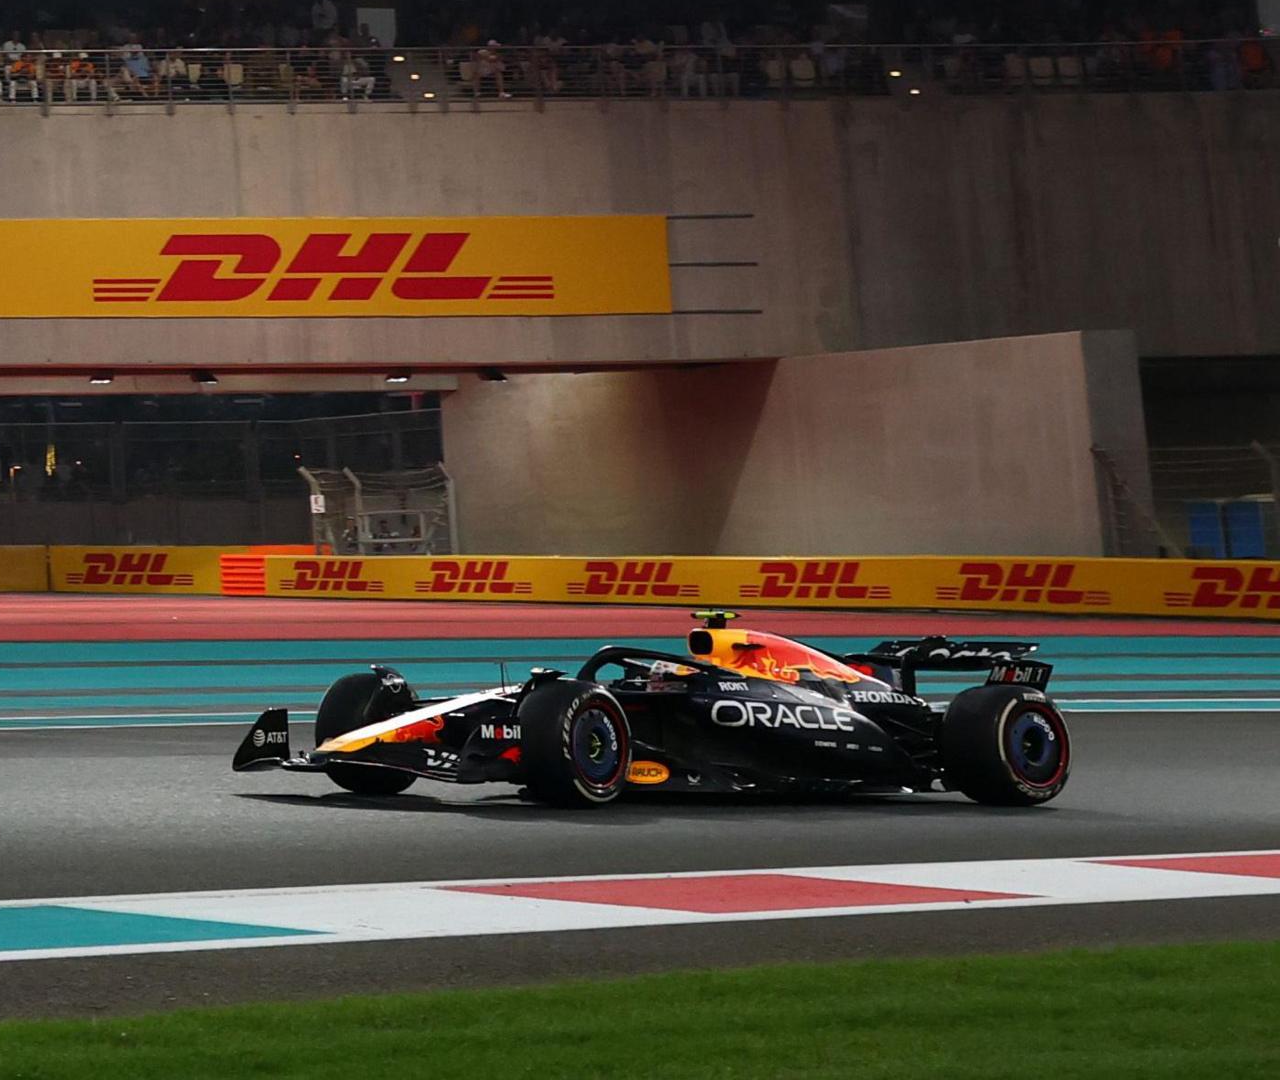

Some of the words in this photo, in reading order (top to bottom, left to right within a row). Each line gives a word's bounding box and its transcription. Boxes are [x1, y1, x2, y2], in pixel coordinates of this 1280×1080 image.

[155, 232, 492, 302] DHL
[82, 553, 175, 586] DHL
[293, 560, 369, 592] DHL
[430, 561, 515, 593] DHL
[583, 561, 680, 597] DHL
[759, 562, 869, 599] DHL
[958, 563, 1085, 604] DHL
[1191, 566, 1280, 609] DH
[853, 690, 918, 706] HONDA
[481, 724, 521, 739] Mobil
[711, 699, 855, 732] ORACLE
[266, 731, 288, 744] AT&T
